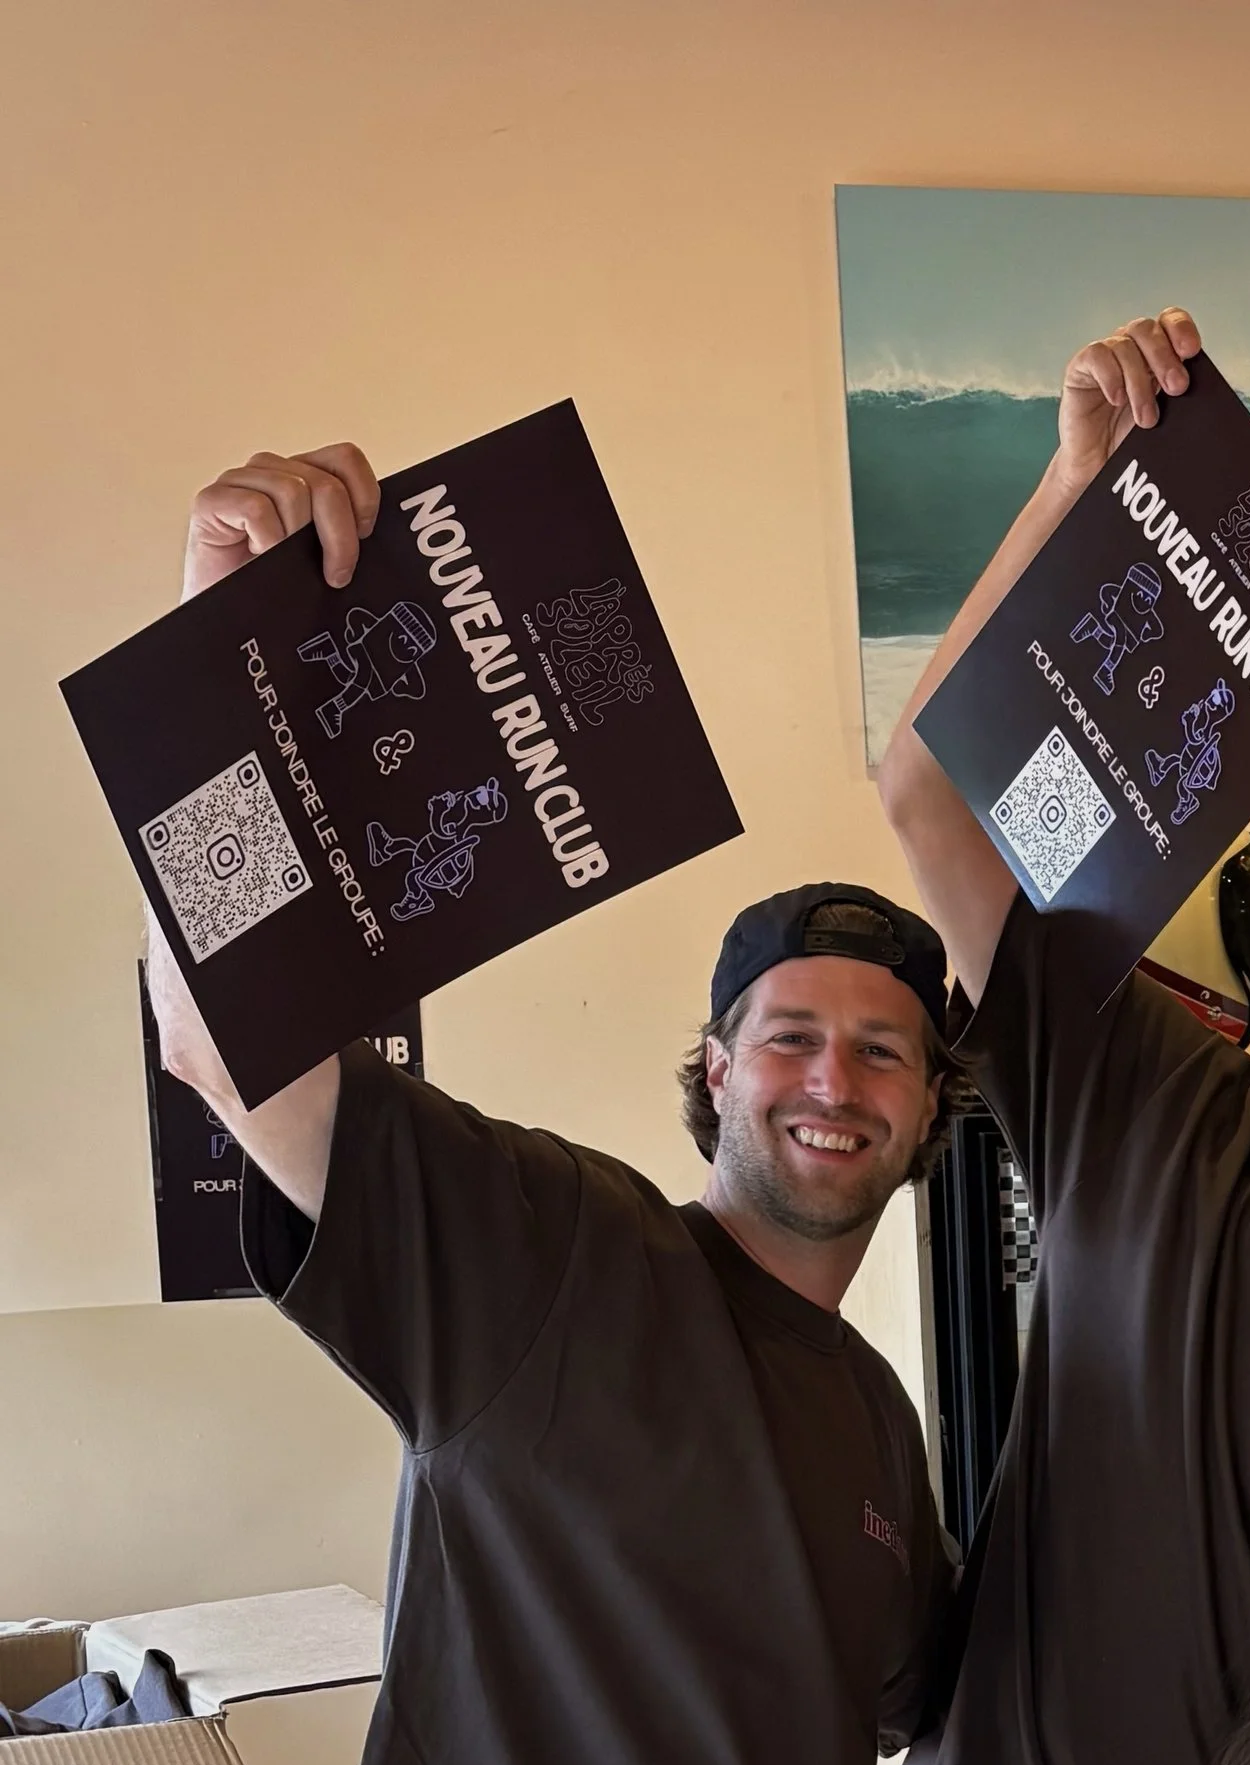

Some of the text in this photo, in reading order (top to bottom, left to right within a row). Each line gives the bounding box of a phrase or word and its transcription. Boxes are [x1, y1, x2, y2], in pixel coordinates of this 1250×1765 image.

[400, 484, 527, 693] NOUVEAU
[1111, 459, 1225, 611] NOUVEAU
[536, 598, 625, 725] SOLEIL
[538, 652, 562, 696] ATELIER
[560, 702, 578, 732] SURF
[1027, 640, 1065, 693] POUR
[1061, 687, 1114, 764] JOINDRE
[1108, 757, 1128, 786] LE
[1138, 665, 1165, 709] &
[240, 637, 278, 712] POUR
[268, 709, 325, 818] JOINDRE
[312, 814, 339, 850] LE
[373, 729, 415, 775] &
[194, 1179, 236, 1193] POUR
